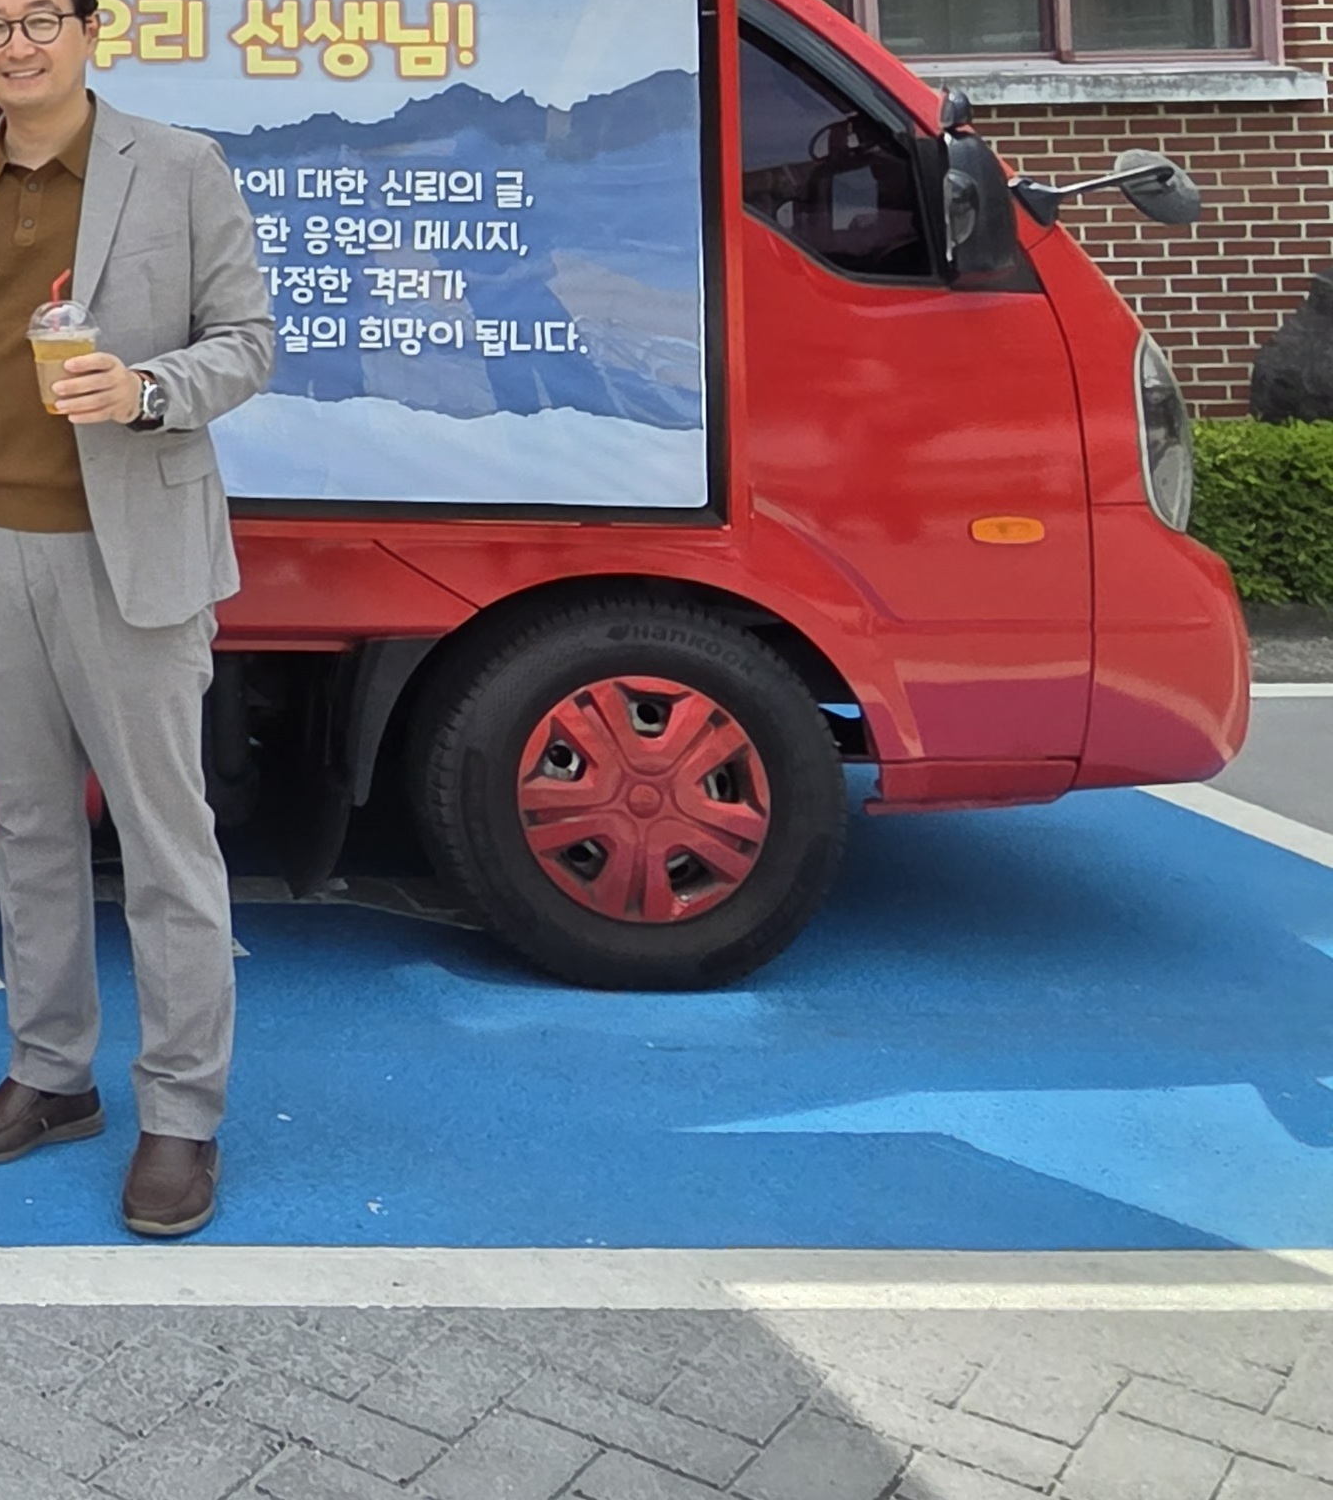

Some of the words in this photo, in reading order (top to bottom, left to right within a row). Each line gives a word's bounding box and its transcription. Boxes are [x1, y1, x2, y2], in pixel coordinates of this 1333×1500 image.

[297, 167, 368, 206] 대한
[380, 169, 482, 206] 신뢰의
[495, 170, 534, 209] 글,
[304, 215, 401, 255] 응원의
[414, 220, 528, 256] 메시지,
[363, 267, 466, 306] 격려가
[359, 316, 464, 356] 희망이
[475, 319, 589, 358] 됩니다.
